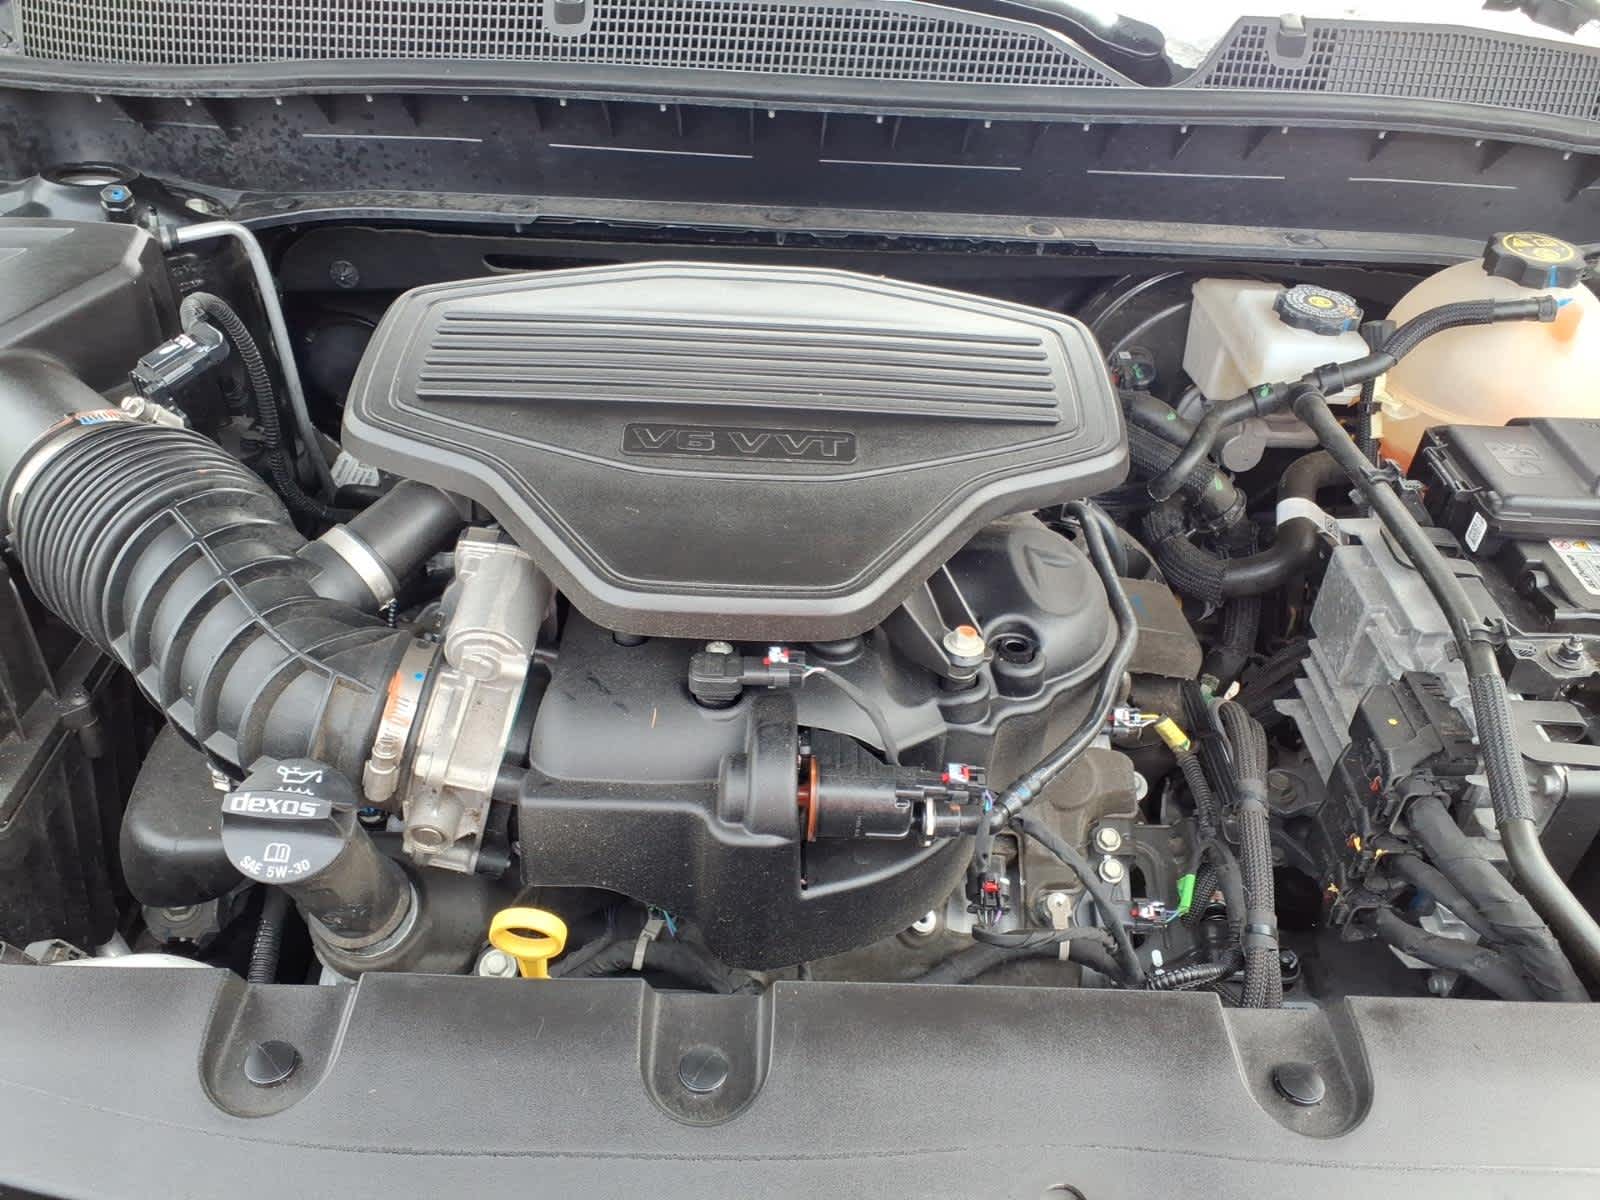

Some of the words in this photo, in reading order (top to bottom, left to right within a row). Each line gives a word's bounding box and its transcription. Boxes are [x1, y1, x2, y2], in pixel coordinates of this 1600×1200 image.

[632, 428, 715, 451] V6
[728, 431, 849, 457] VVT
[230, 792, 321, 817] dexos
[240, 856, 263, 875] SAE
[266, 859, 311, 879] 5W-30
